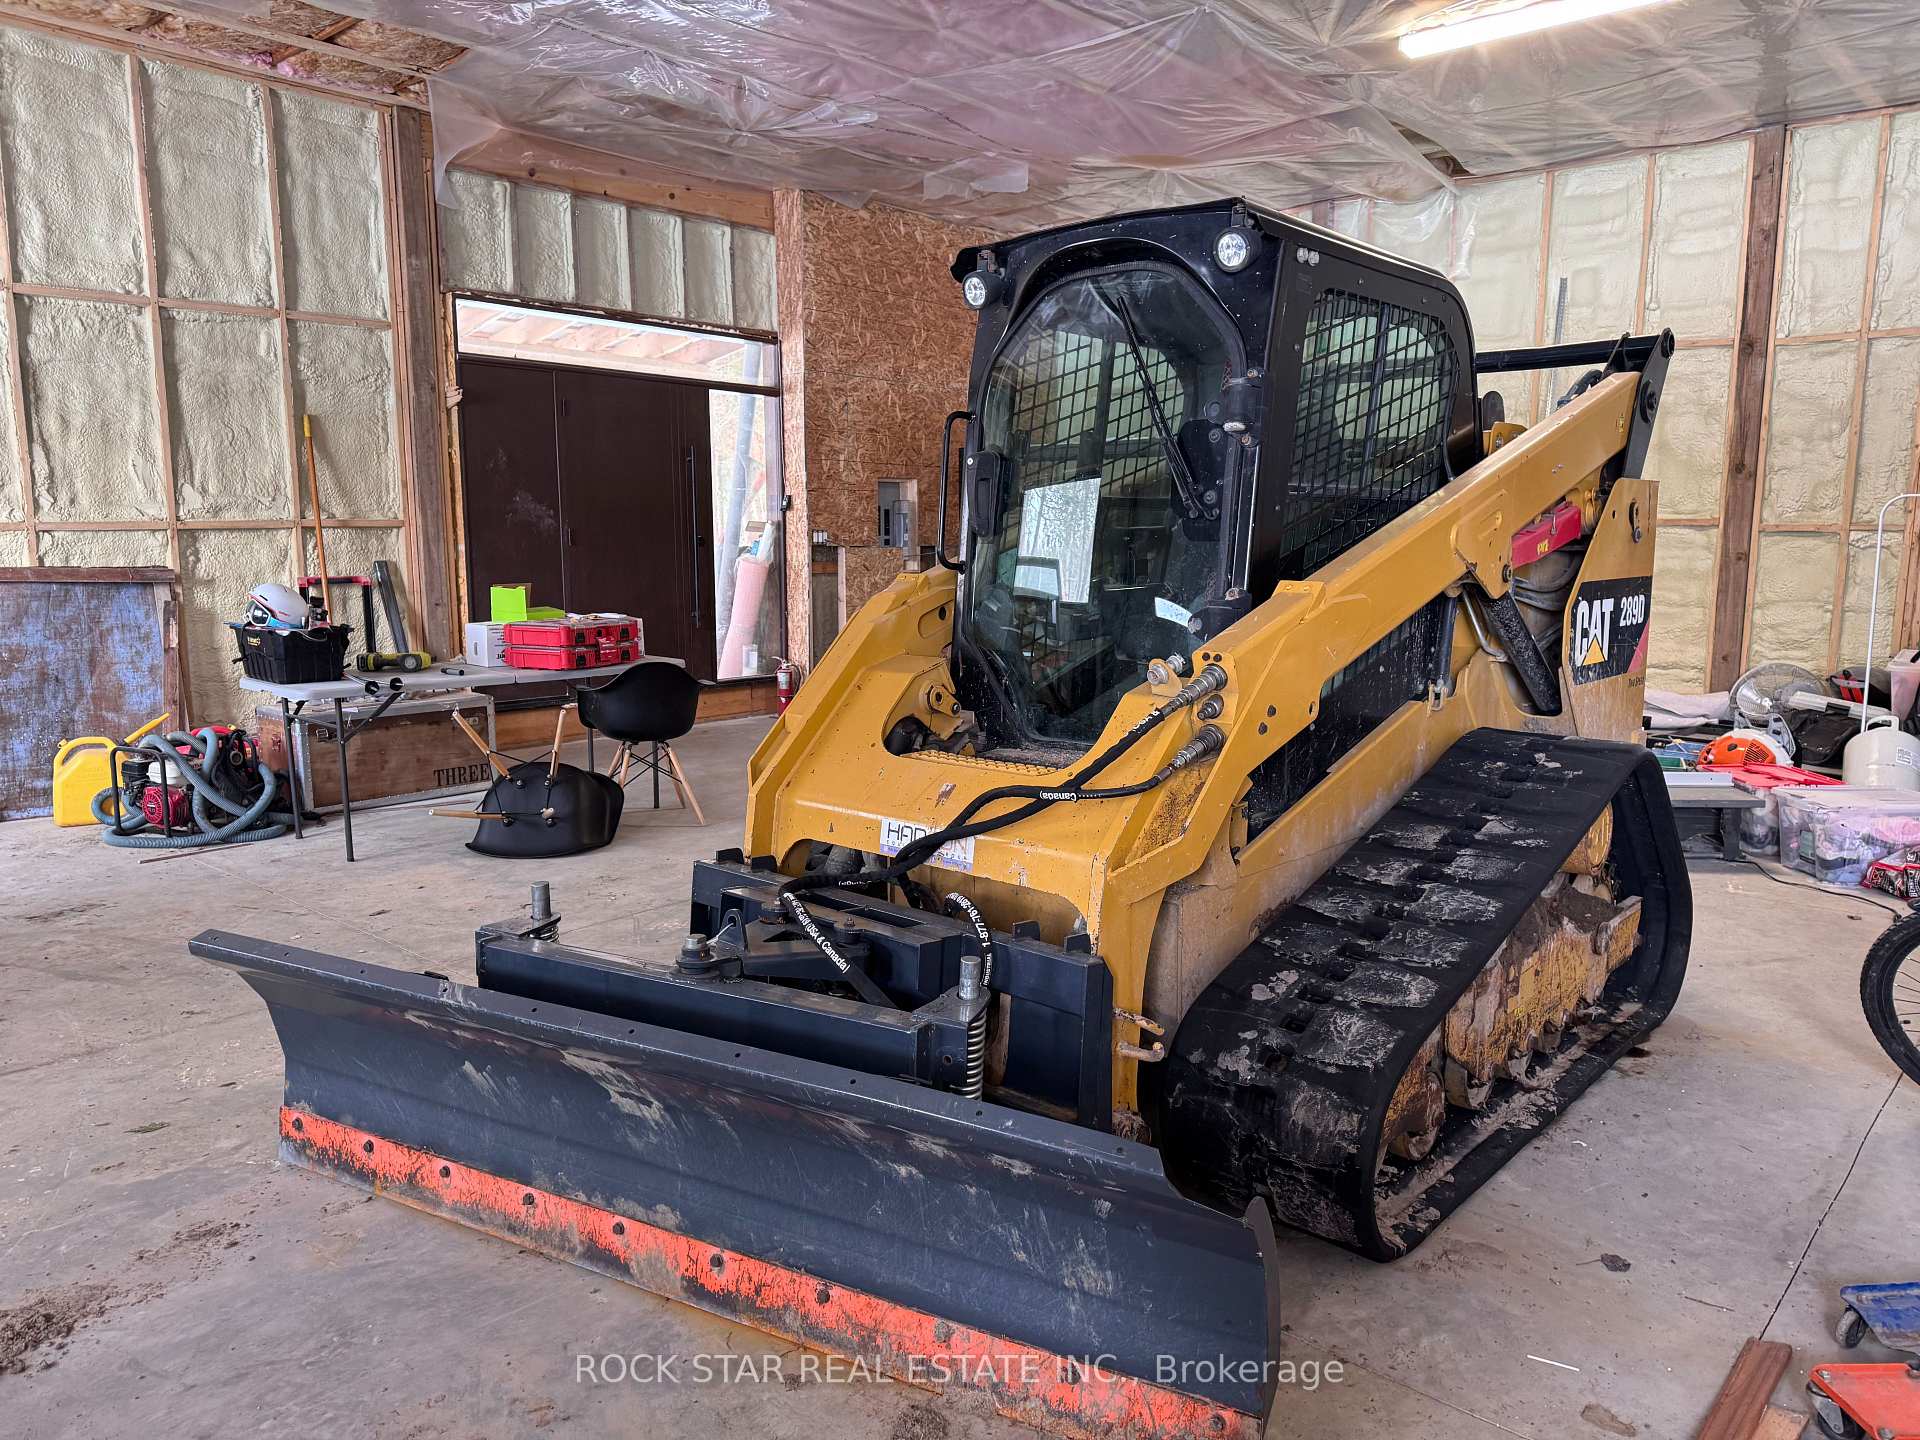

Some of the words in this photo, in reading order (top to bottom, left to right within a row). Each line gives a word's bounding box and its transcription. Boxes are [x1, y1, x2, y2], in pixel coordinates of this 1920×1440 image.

[1620, 594, 1645, 626] 289D
[1575, 598, 1614, 666] CAT
[433, 763, 490, 786] THREE
[1039, 790, 1077, 801] Canada)
